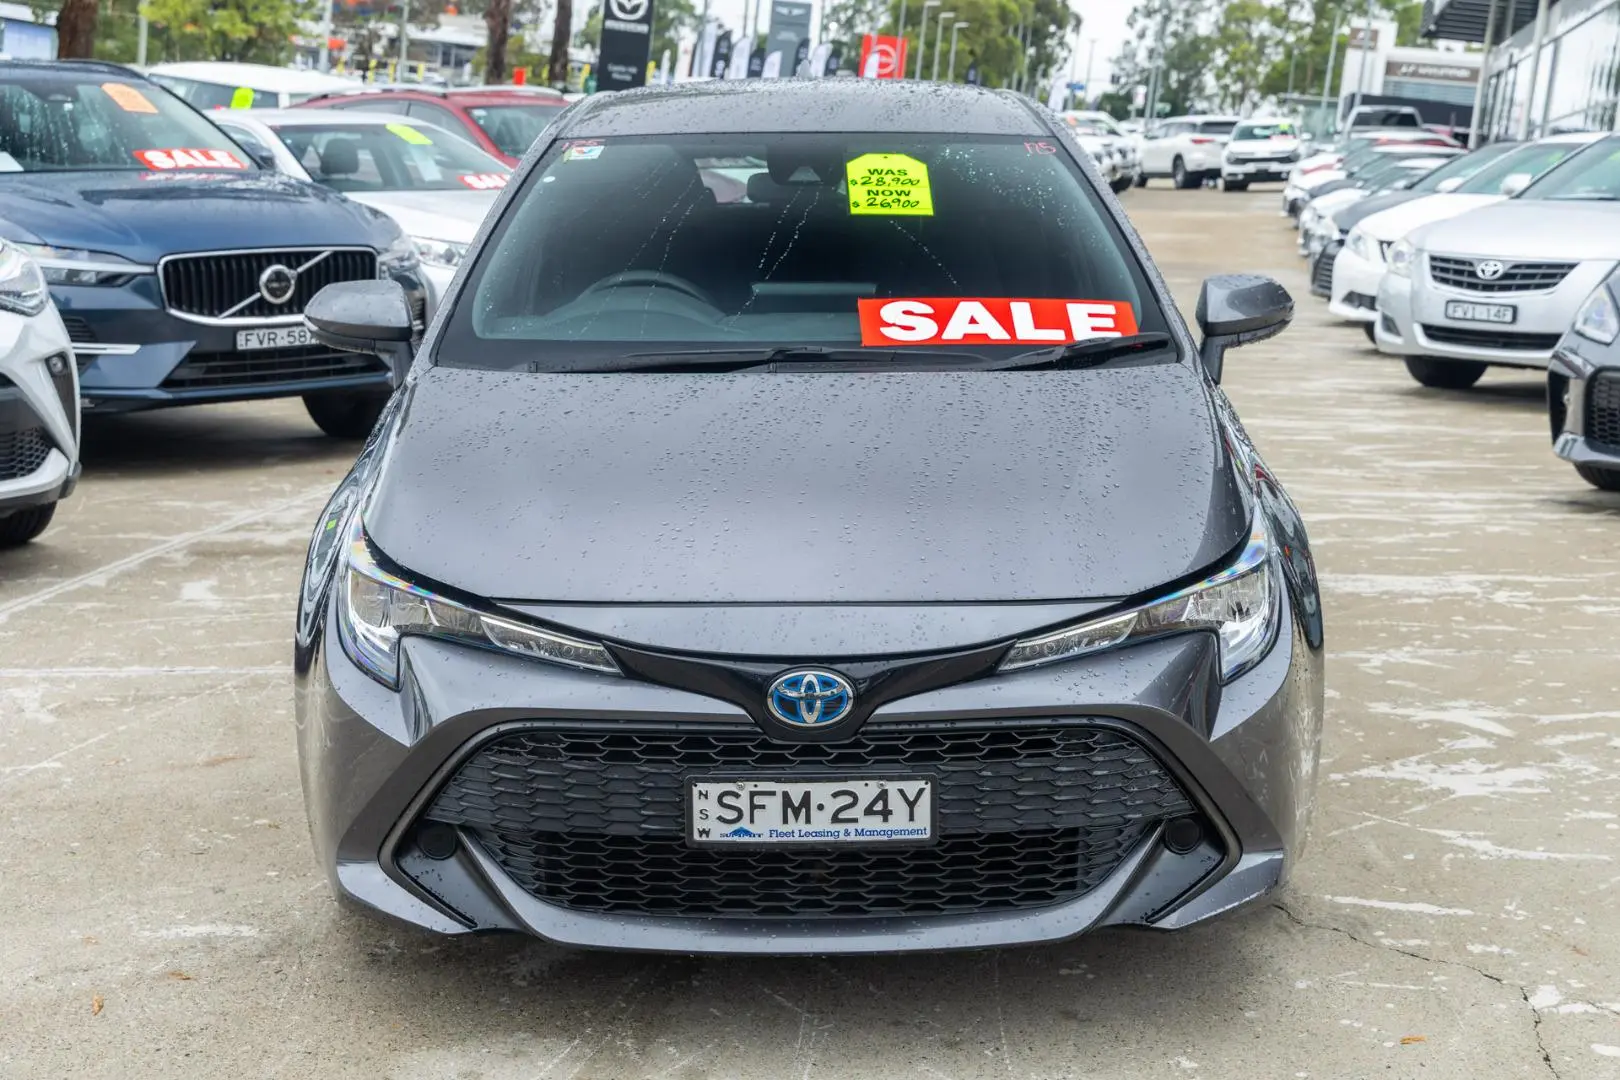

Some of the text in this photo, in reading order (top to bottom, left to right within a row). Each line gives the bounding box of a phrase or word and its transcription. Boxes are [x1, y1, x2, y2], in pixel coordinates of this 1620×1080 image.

[144, 150, 243, 169] SALE
[867, 168, 908, 176] WAS
[867, 189, 911, 197] NOW
[879, 300, 1122, 341] SALE
[769, 829, 795, 838] Fleet
[798, 828, 841, 839] Leasing
[843, 828, 852, 837] &
[854, 827, 927, 839] Management
